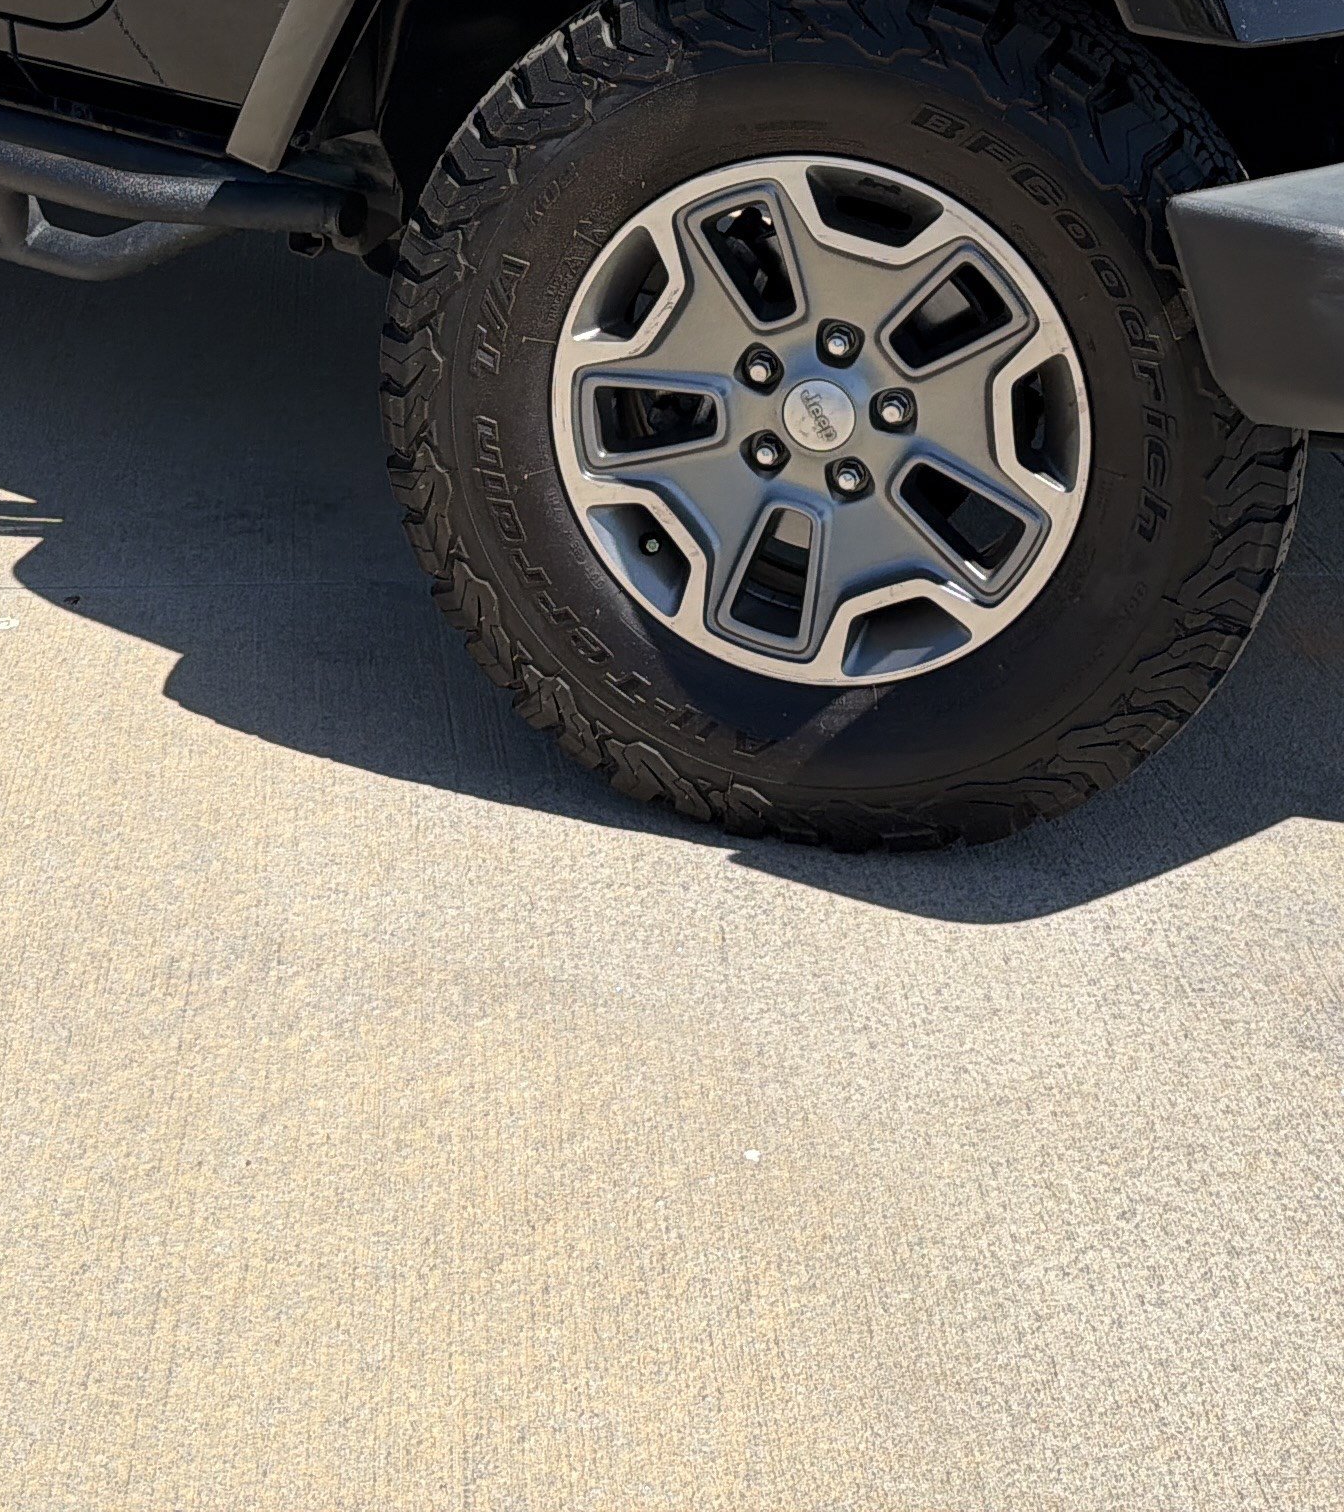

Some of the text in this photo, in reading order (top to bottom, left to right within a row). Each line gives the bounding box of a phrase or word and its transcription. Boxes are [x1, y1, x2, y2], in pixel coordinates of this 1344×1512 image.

[470, 252, 531, 376] T/A
[800, 389, 838, 442] Jeep
[910, 102, 1178, 544] BFGoodrich
[474, 414, 780, 758] All-Terrain
